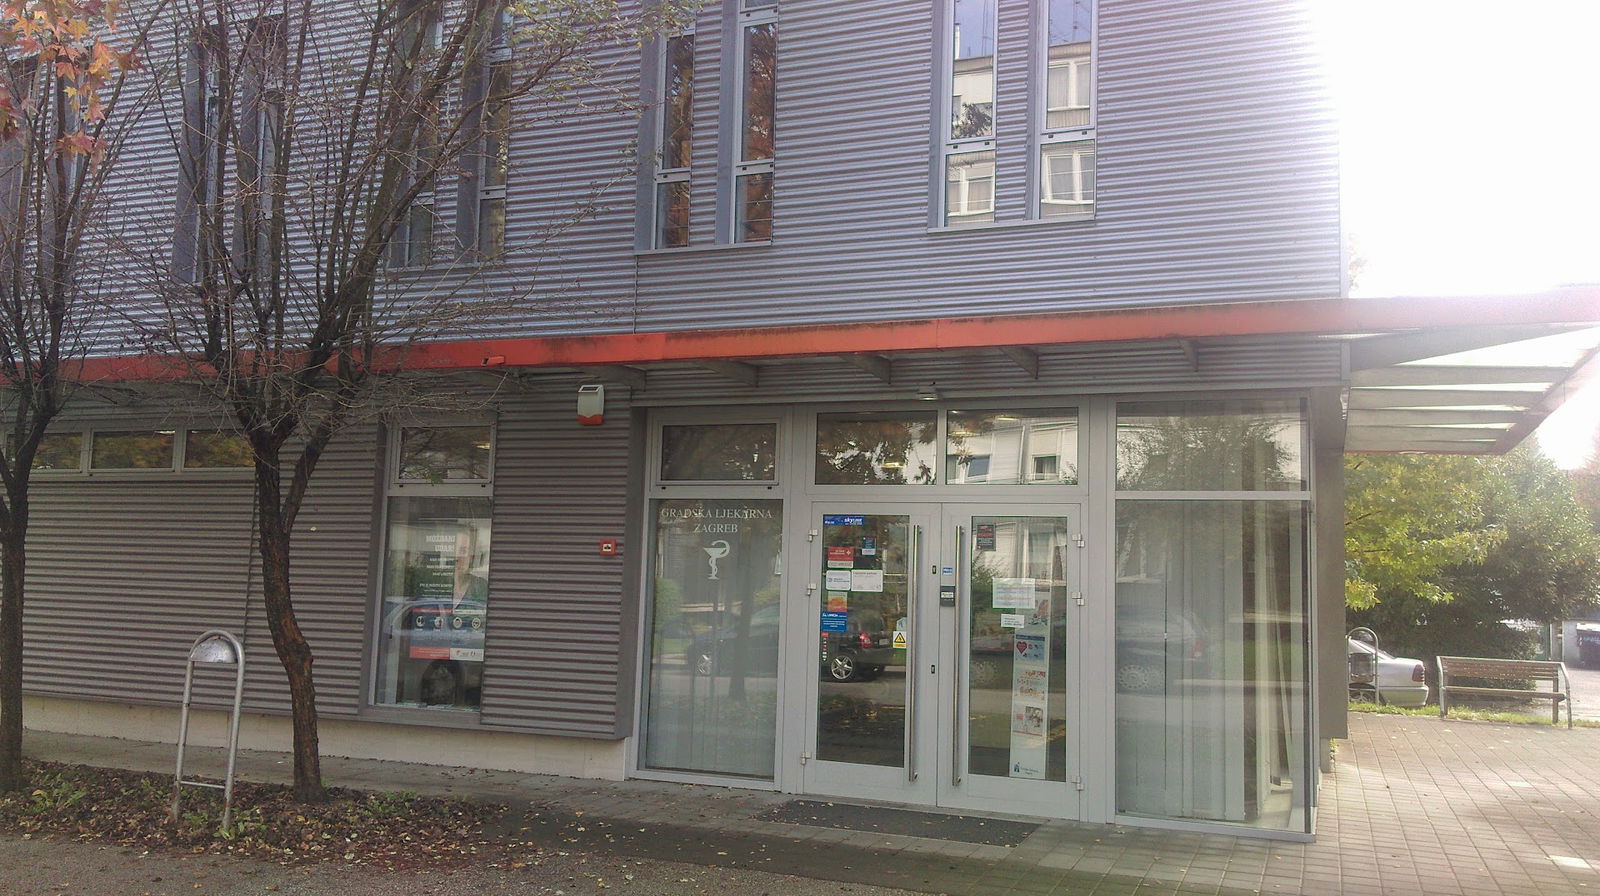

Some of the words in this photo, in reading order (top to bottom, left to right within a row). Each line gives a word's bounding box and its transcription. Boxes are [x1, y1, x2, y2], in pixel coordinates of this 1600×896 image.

[661, 508, 712, 518] GRADSKA
[715, 508, 773, 519] LJEKARNA
[693, 523, 738, 533] ZAGREB
